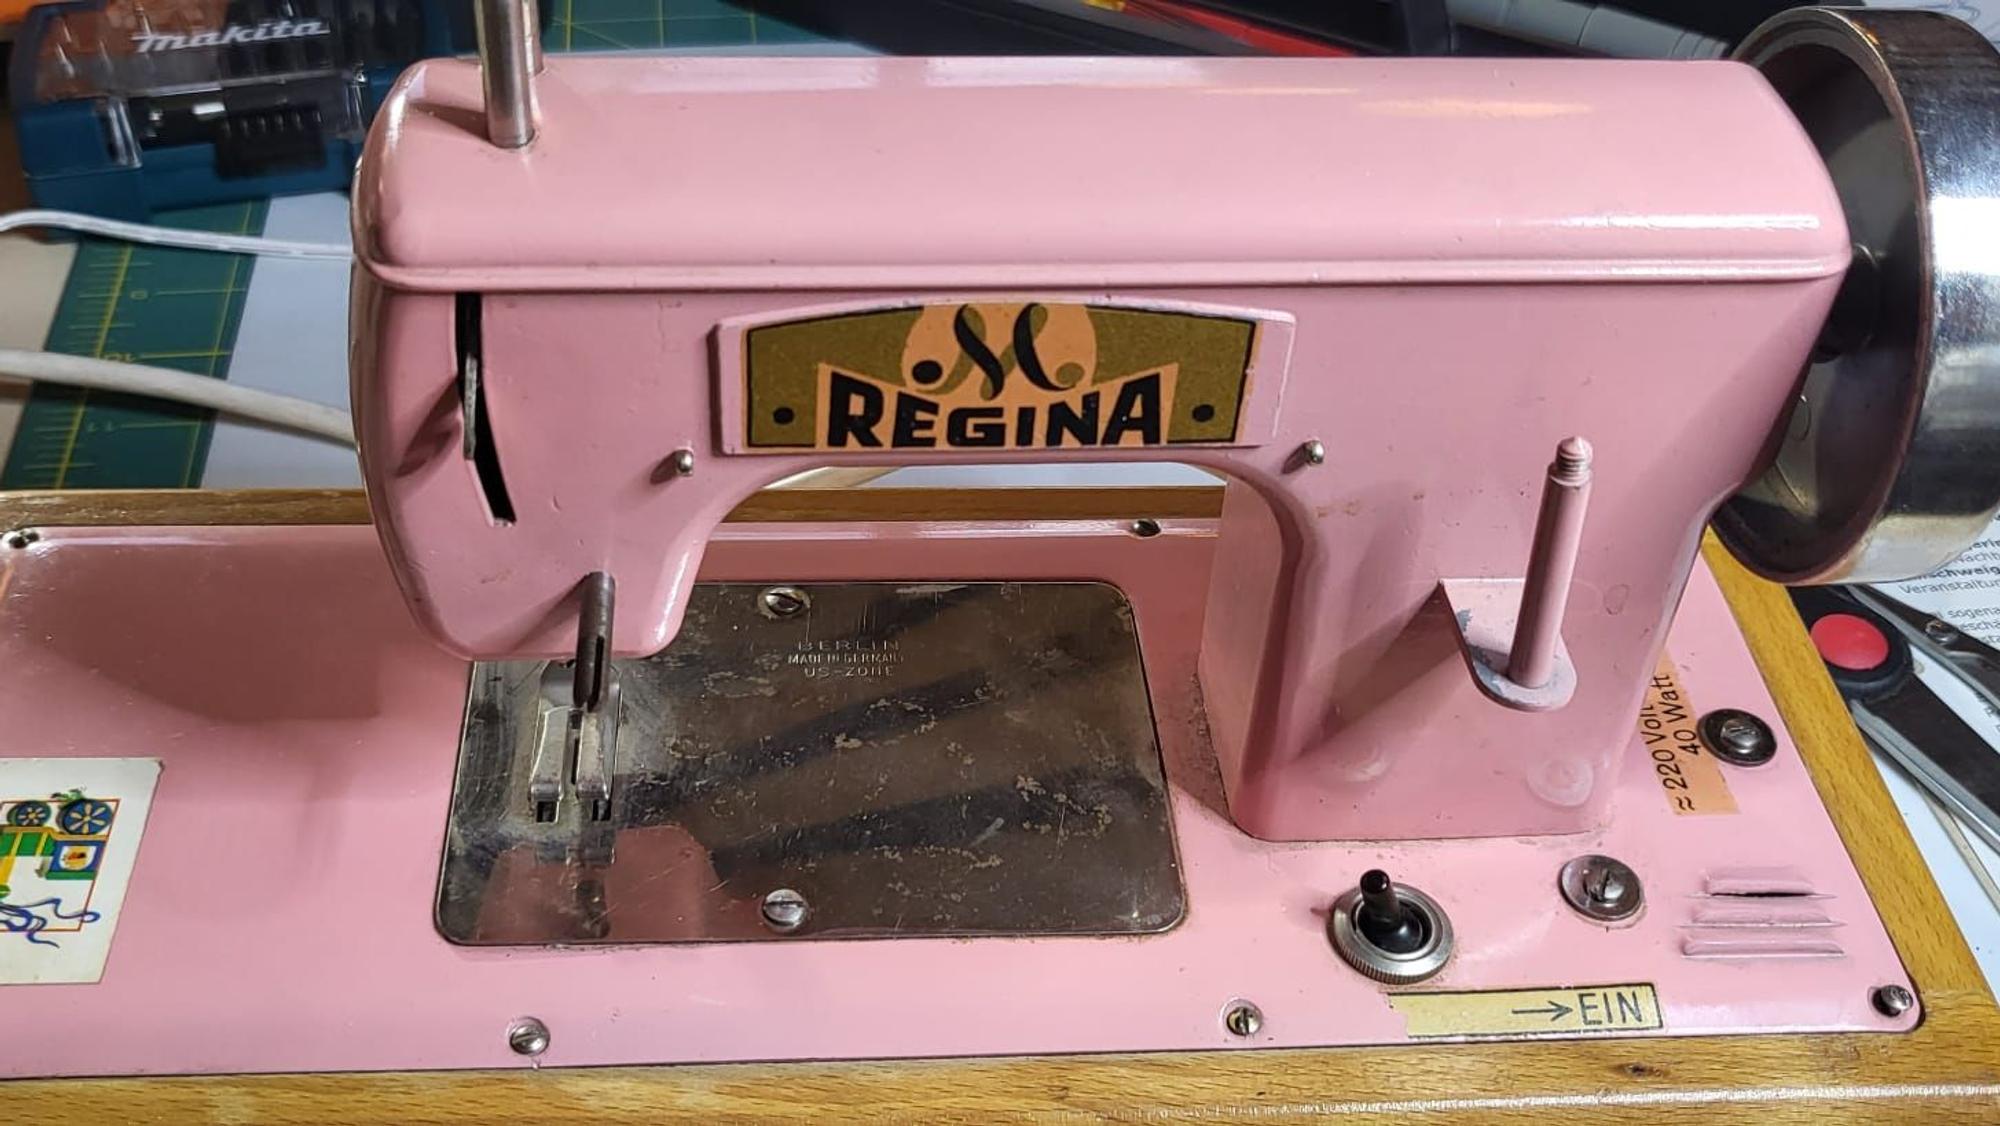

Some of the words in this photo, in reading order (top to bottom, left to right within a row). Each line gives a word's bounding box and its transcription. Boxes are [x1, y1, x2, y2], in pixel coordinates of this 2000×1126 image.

[132, 21, 331, 53] makita
[827, 372, 1161, 448] REGINA
[787, 653, 822, 664] MADE
[798, 640, 900, 651] BERLIN
[804, 666, 895, 678] US-ZONE
[1650, 674, 1689, 724] Watt
[1672, 729, 1702, 756] 40
[1651, 749, 1689, 790] 220
[1577, 991, 1643, 1026] EIN
